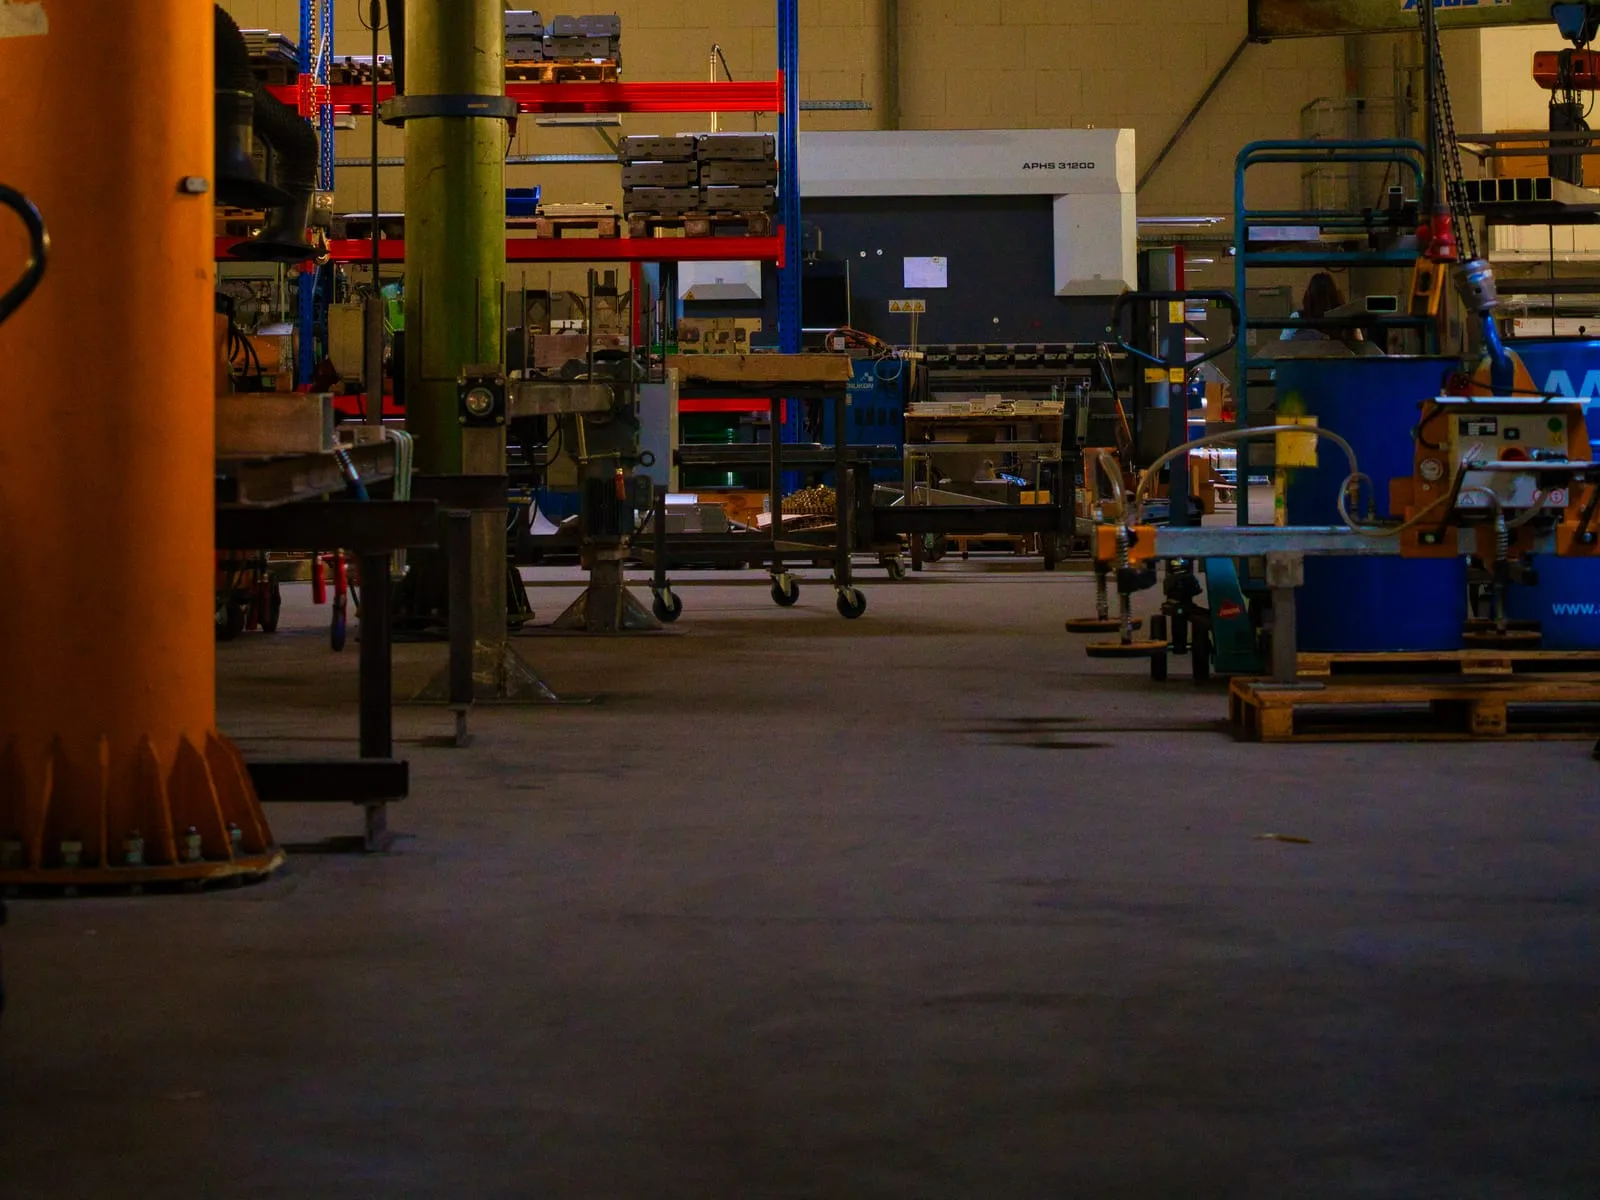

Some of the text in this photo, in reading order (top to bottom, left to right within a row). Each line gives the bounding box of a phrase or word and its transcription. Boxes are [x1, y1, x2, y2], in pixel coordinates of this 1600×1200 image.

[1022, 161, 1095, 170] APHS 31200
[1552, 603, 1600, 615] www.
